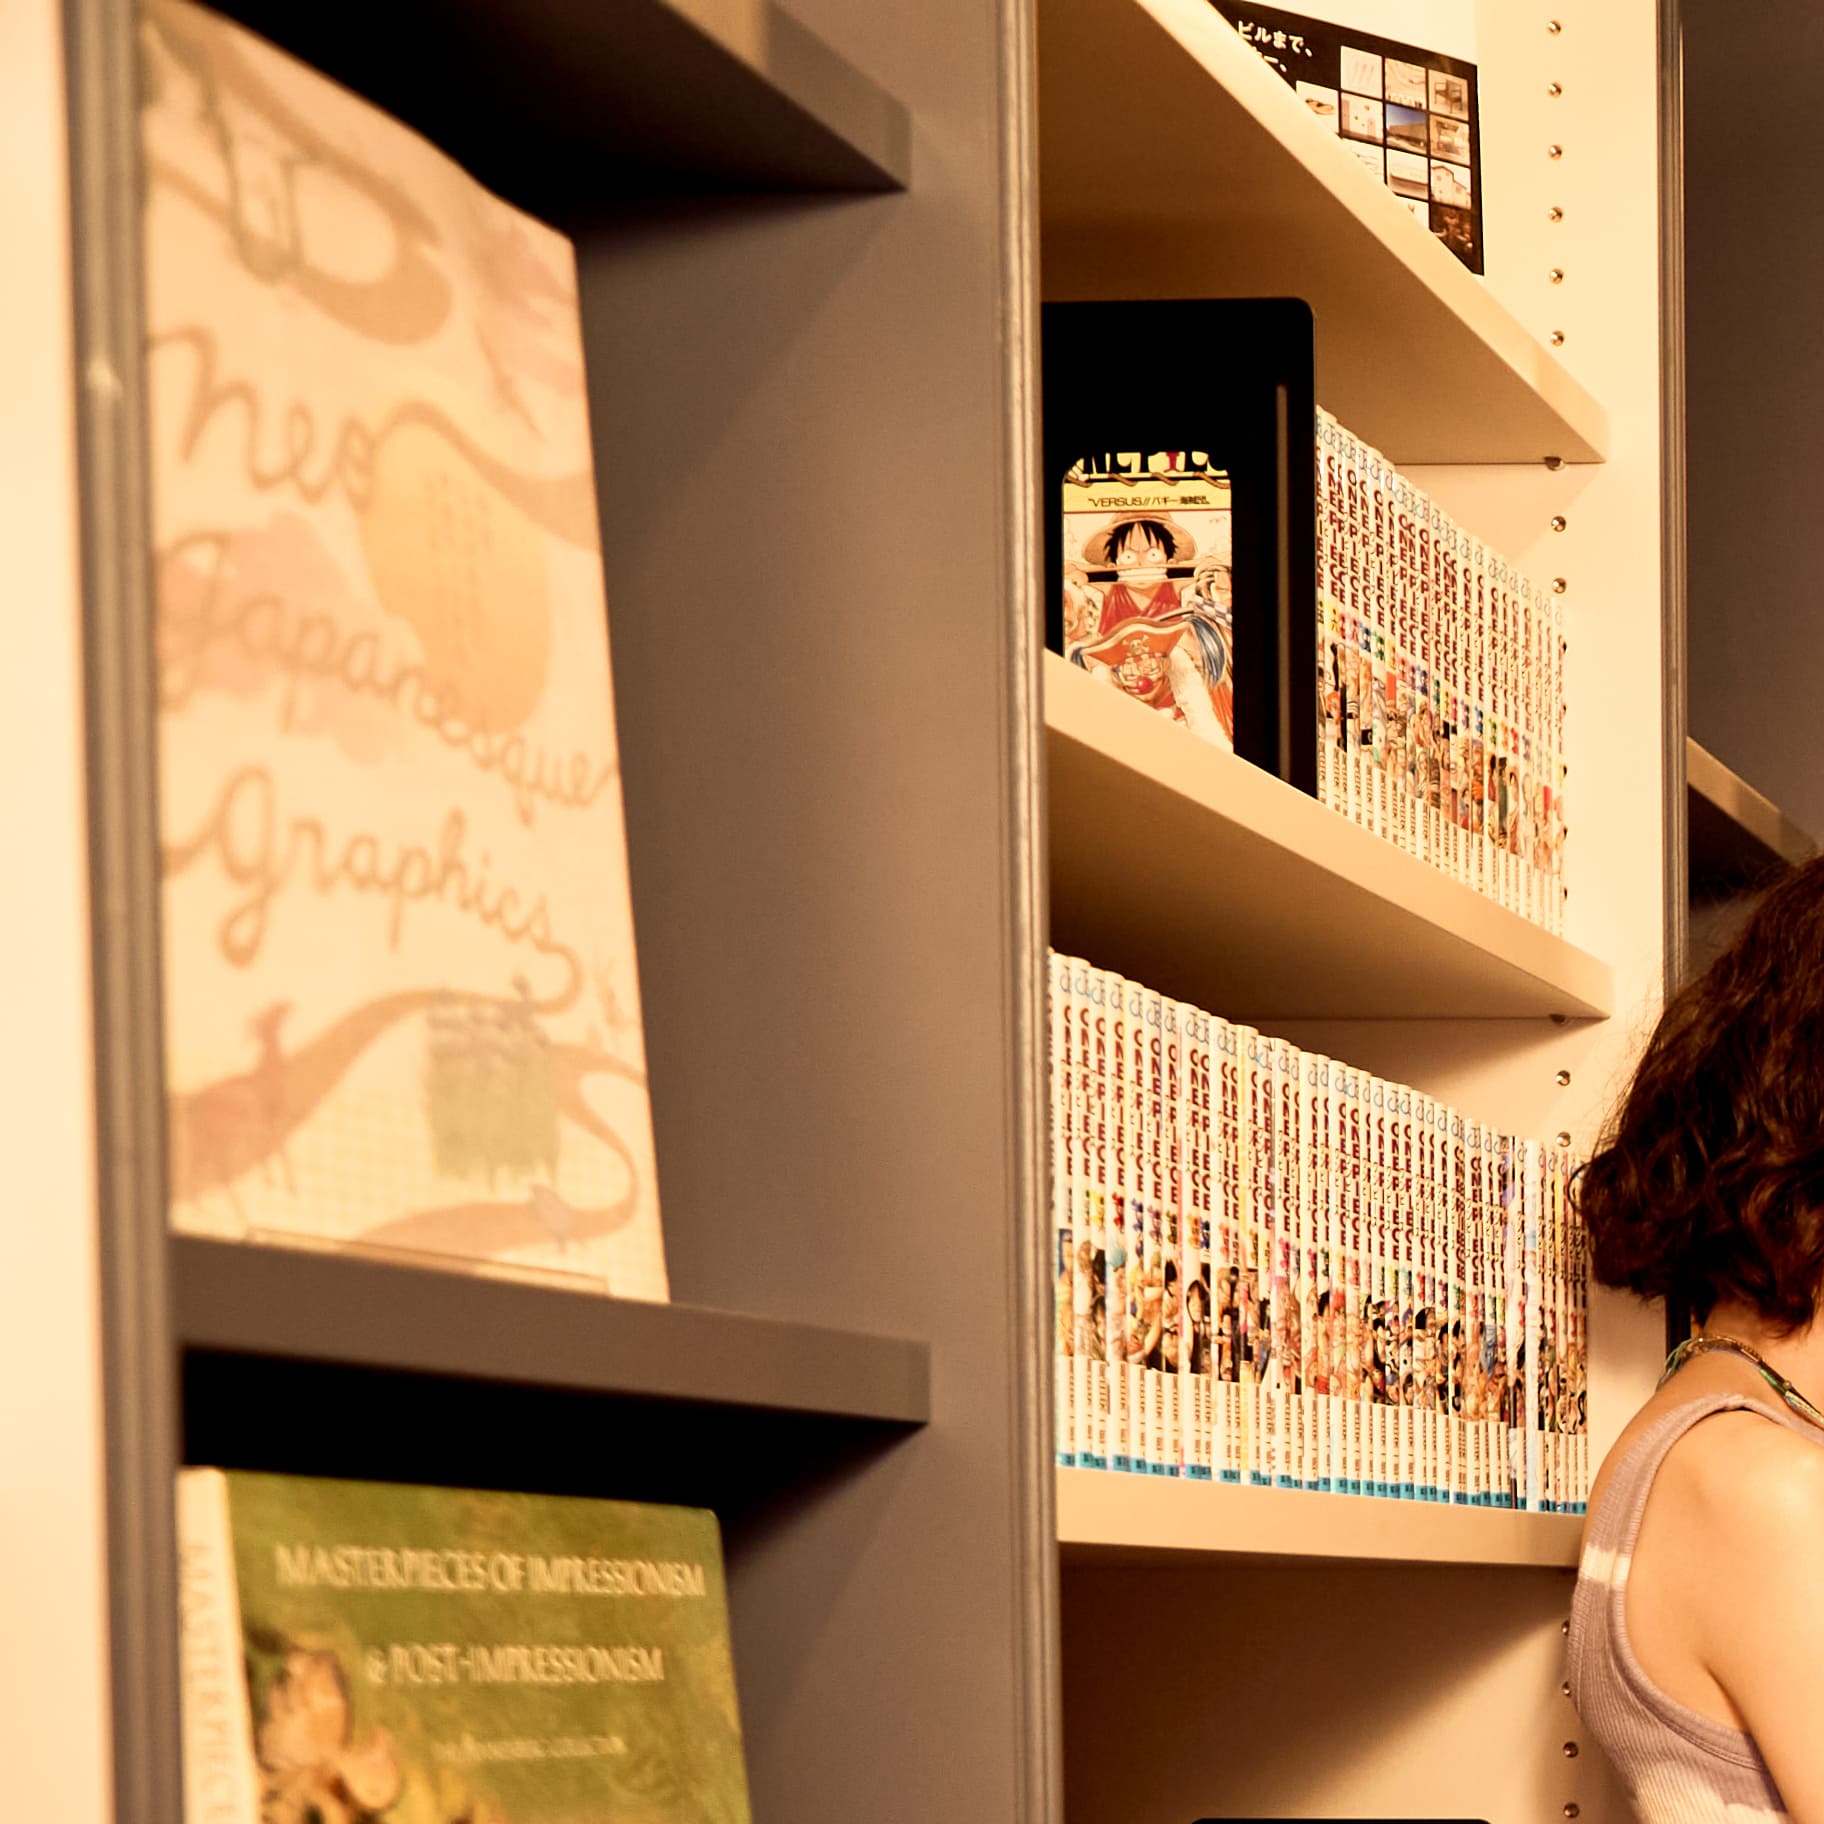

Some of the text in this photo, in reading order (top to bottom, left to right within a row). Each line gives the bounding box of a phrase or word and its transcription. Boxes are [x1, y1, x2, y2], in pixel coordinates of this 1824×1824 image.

[1238, 19, 1314, 58] ビルまで、
[1349, 523, 1360, 609] PIECE
[1373, 543, 1385, 627] PIECE
[1400, 566, 1409, 648] PIECE
[1409, 575, 1419, 655] PIECE
[1421, 580, 1430, 662] PIECE
[274, 1545, 706, 1597] MASTERPIECES OF IMPRESSIONISM
[364, 1644, 664, 1685] & POST-IMPRESSIONISM
